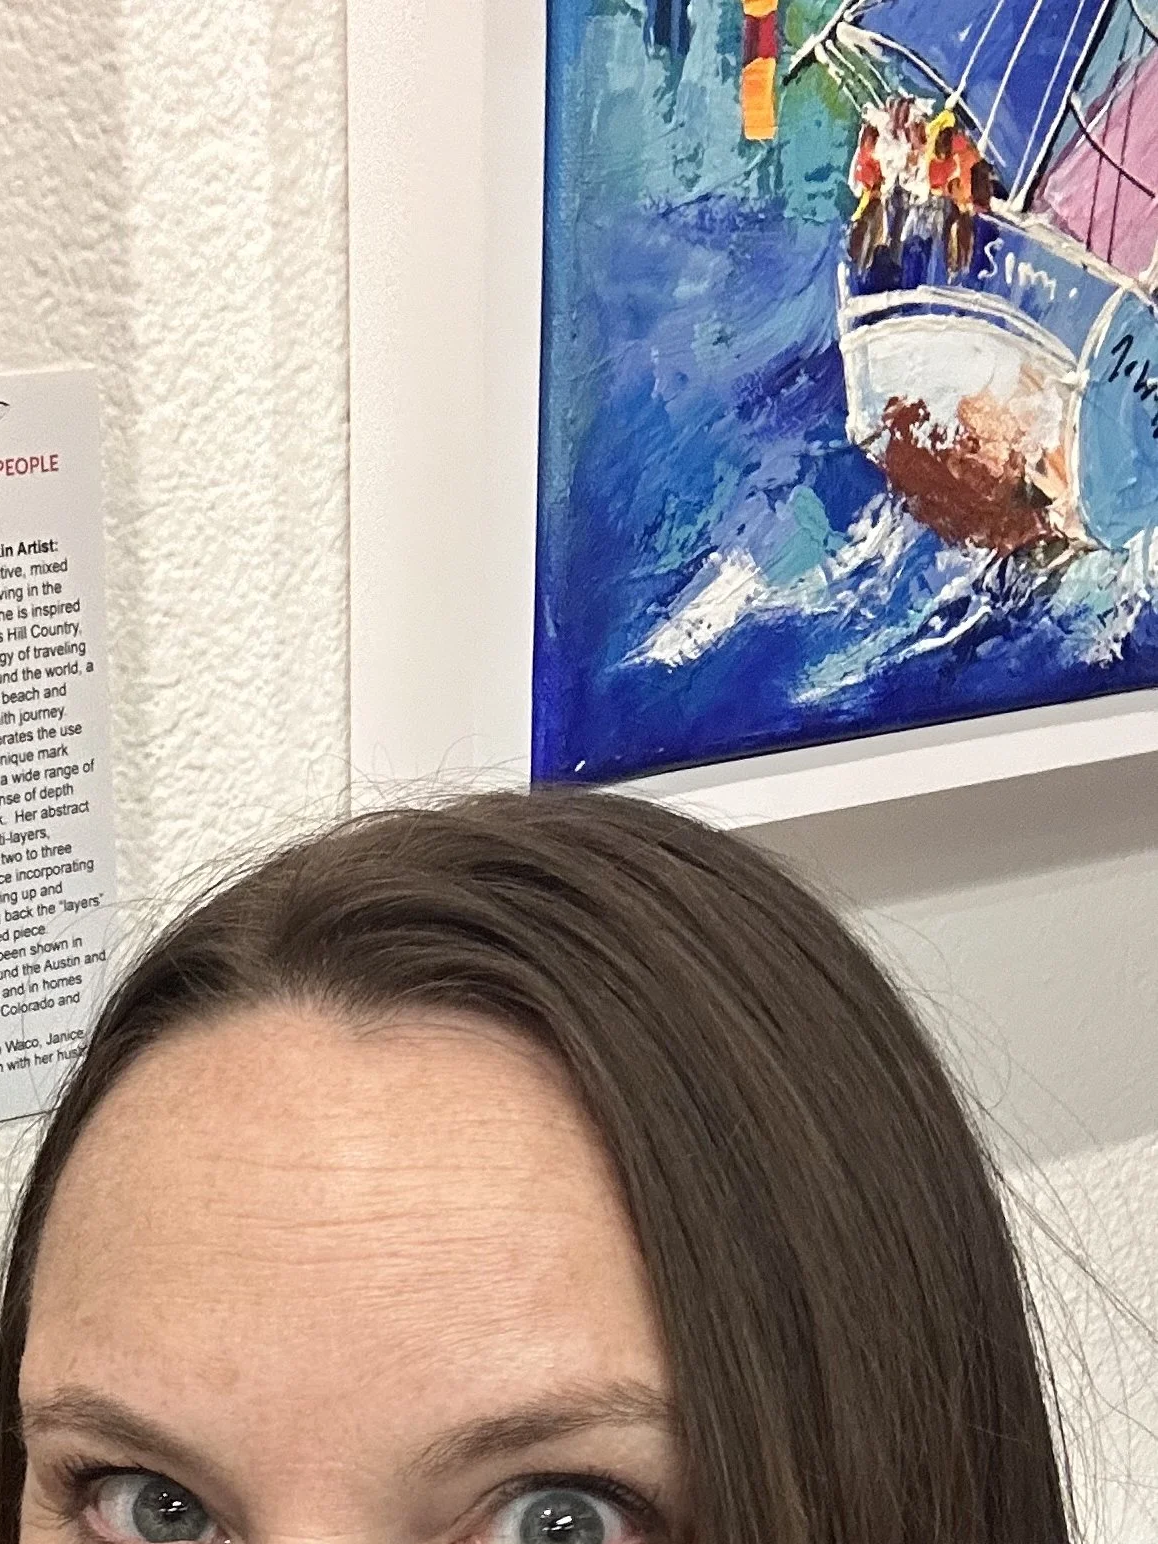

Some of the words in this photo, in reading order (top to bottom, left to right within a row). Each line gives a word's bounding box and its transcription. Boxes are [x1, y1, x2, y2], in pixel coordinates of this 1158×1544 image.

[17, 539, 58, 555] Artist:
[30, 558, 68, 576] mixed
[28, 584, 38, 597] in
[42, 581, 62, 595] the
[18, 607, 27, 619] is
[32, 599, 80, 619] inspired
[7, 627, 26, 641] Hill
[18, 648, 31, 661] of
[34, 642, 86, 658] traveling
[22, 667, 41, 681] the
[86, 661, 94, 672] a
[2, 688, 39, 705] beach
[44, 684, 67, 698] and
[37, 726, 56, 740] the
[60, 723, 82, 736] use
[38, 744, 68, 759] mark
[1, 774, 8, 785] a
[12, 768, 40, 783] wide
[44, 761, 79, 779] range
[83, 759, 95, 772] of
[25, 789, 36, 802] of
[40, 783, 74, 802] depth
[15, 809, 38, 823] Her
[41, 801, 90, 819] abstract
[1, 851, 22, 865] two
[26, 849, 37, 861] to
[42, 843, 72, 858] three
[15, 858, 94, 882] incorporating
[21, 888, 36, 901] up
[40, 882, 63, 897] and
[5, 906, 32, 922] back
[37, 902, 56, 917] the
[30, 939, 69, 956] shown
[72, 935, 82, 948] in
[23, 962, 41, 977] the
[44, 955, 80, 972] Austin
[84, 950, 106, 963] and
[3, 984, 25, 998] and
[29, 981, 39, 993] in
[43, 974, 82, 991] homes
[0, 998, 55, 1017] Colorado
[59, 992, 80, 1007] and
[46, 1029, 84, 1046] Janice
[7, 1057, 30, 1071] with
[34, 1052, 53, 1065] her
